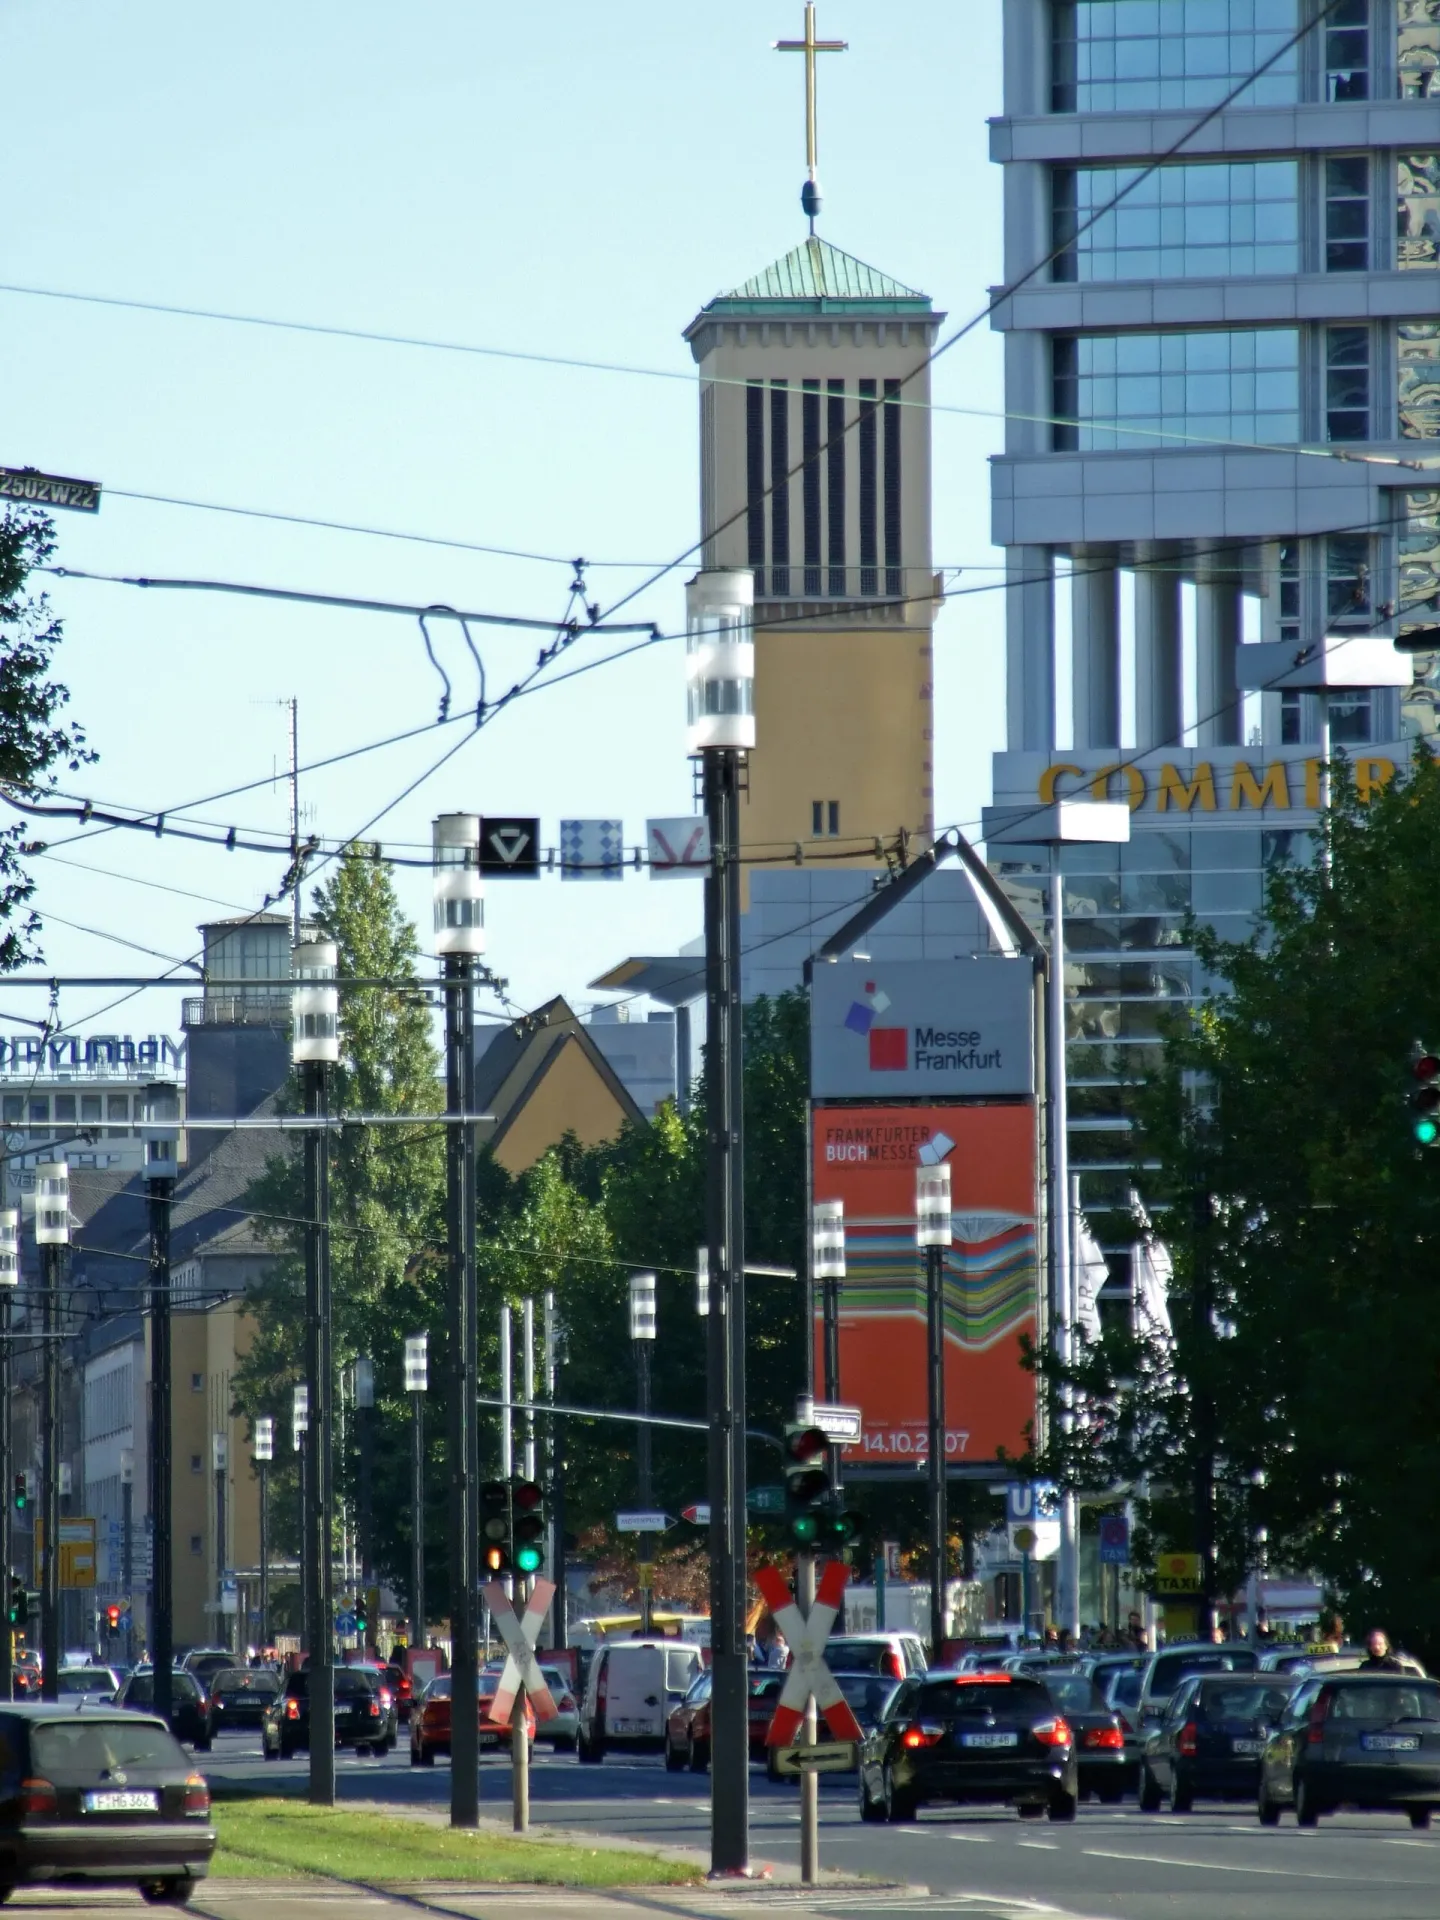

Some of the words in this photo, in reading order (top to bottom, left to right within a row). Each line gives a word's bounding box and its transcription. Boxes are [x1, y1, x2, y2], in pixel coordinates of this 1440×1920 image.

[915, 1028, 981, 1048] Messe
[915, 1049, 1002, 1070] Frankfurt
[826, 1126, 930, 1143] FRANKFURTER
[826, 1144, 917, 1161] BUCHMESSE
[862, 1432, 969, 1453] 14.10.207
[1012, 1489, 1031, 1516] U
[1103, 1549, 1126, 1560] TAXI
[1162, 1578, 1196, 1590] TAXI
[129, 1795, 149, 1807] 362
